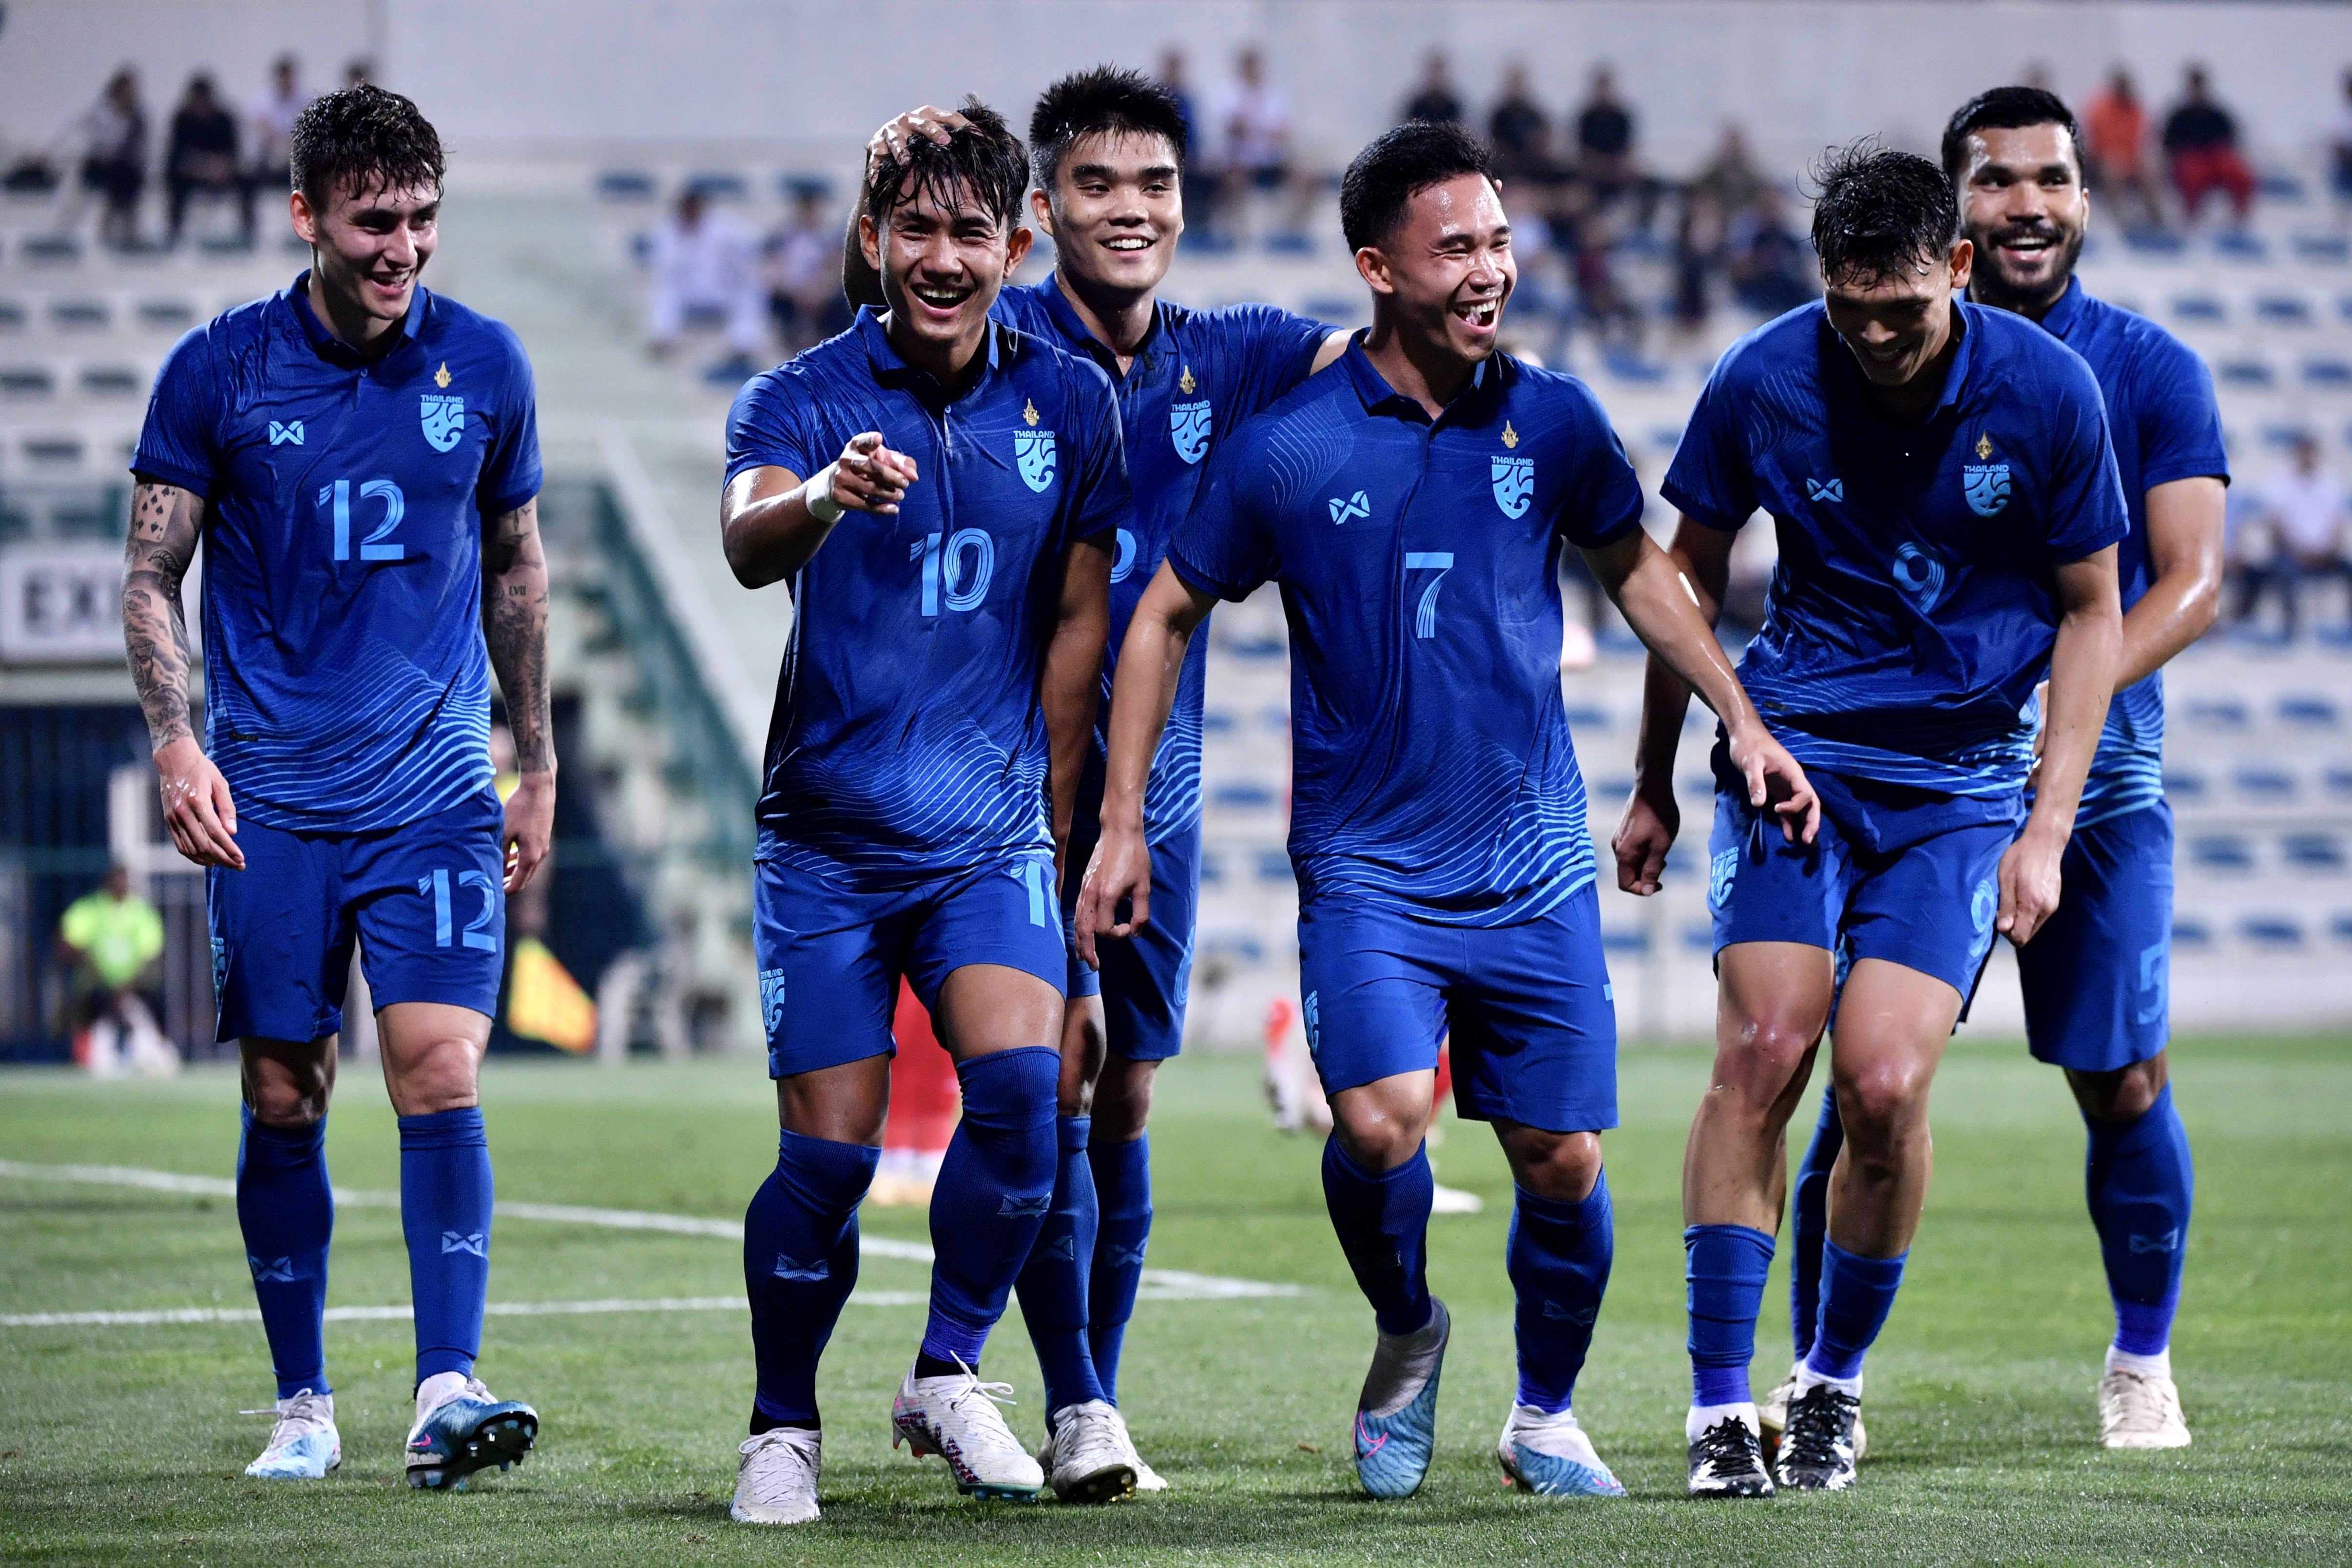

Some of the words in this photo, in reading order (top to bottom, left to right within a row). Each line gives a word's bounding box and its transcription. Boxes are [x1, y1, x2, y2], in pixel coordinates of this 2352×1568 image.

[420, 394, 464, 404] THAILAND
[1013, 430, 1055, 439] THAILAND
[1171, 400, 1211, 412] THAILAND
[1491, 455, 1534, 466] THAILAND
[1963, 464, 2009, 473] THAILAND
[318, 479, 405, 561] 12
[909, 527, 995, 617] 10
[1406, 552, 1454, 639] 7
[1892, 541, 1945, 614] 9
[418, 869, 497, 953] 12
[1970, 879, 1994, 958] 9
[2139, 943, 2167, 1025] 5
